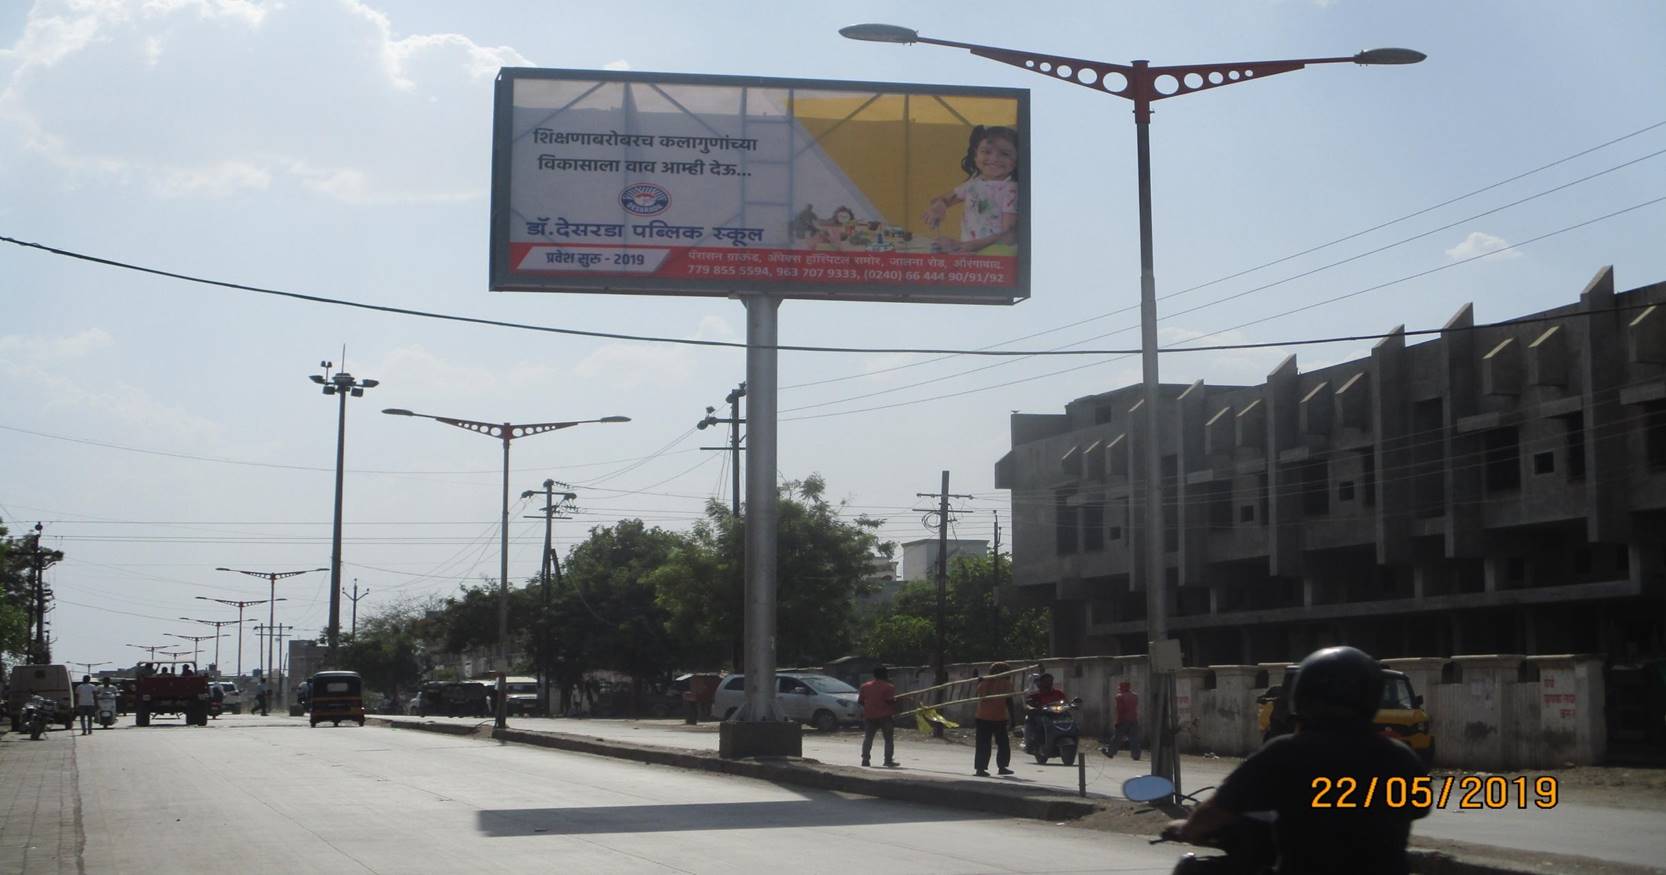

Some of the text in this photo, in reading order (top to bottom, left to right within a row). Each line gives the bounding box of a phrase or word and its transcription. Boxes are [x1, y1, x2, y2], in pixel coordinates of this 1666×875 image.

[533, 127, 758, 154] शिक्षणाबरोबरच कलागुणांच्या
[537, 154, 752, 177] विकासाला वाव आम्ही देऊ...
[632, 219, 704, 240] पब्लिक
[712, 226, 764, 246] स्कूल
[546, 249, 575, 264] प्रवेश
[614, 253, 645, 266] 2019
[688, 264, 1004, 283] 779 855 5594, 963 707 9333, (0240) 66 444 90/91/92
